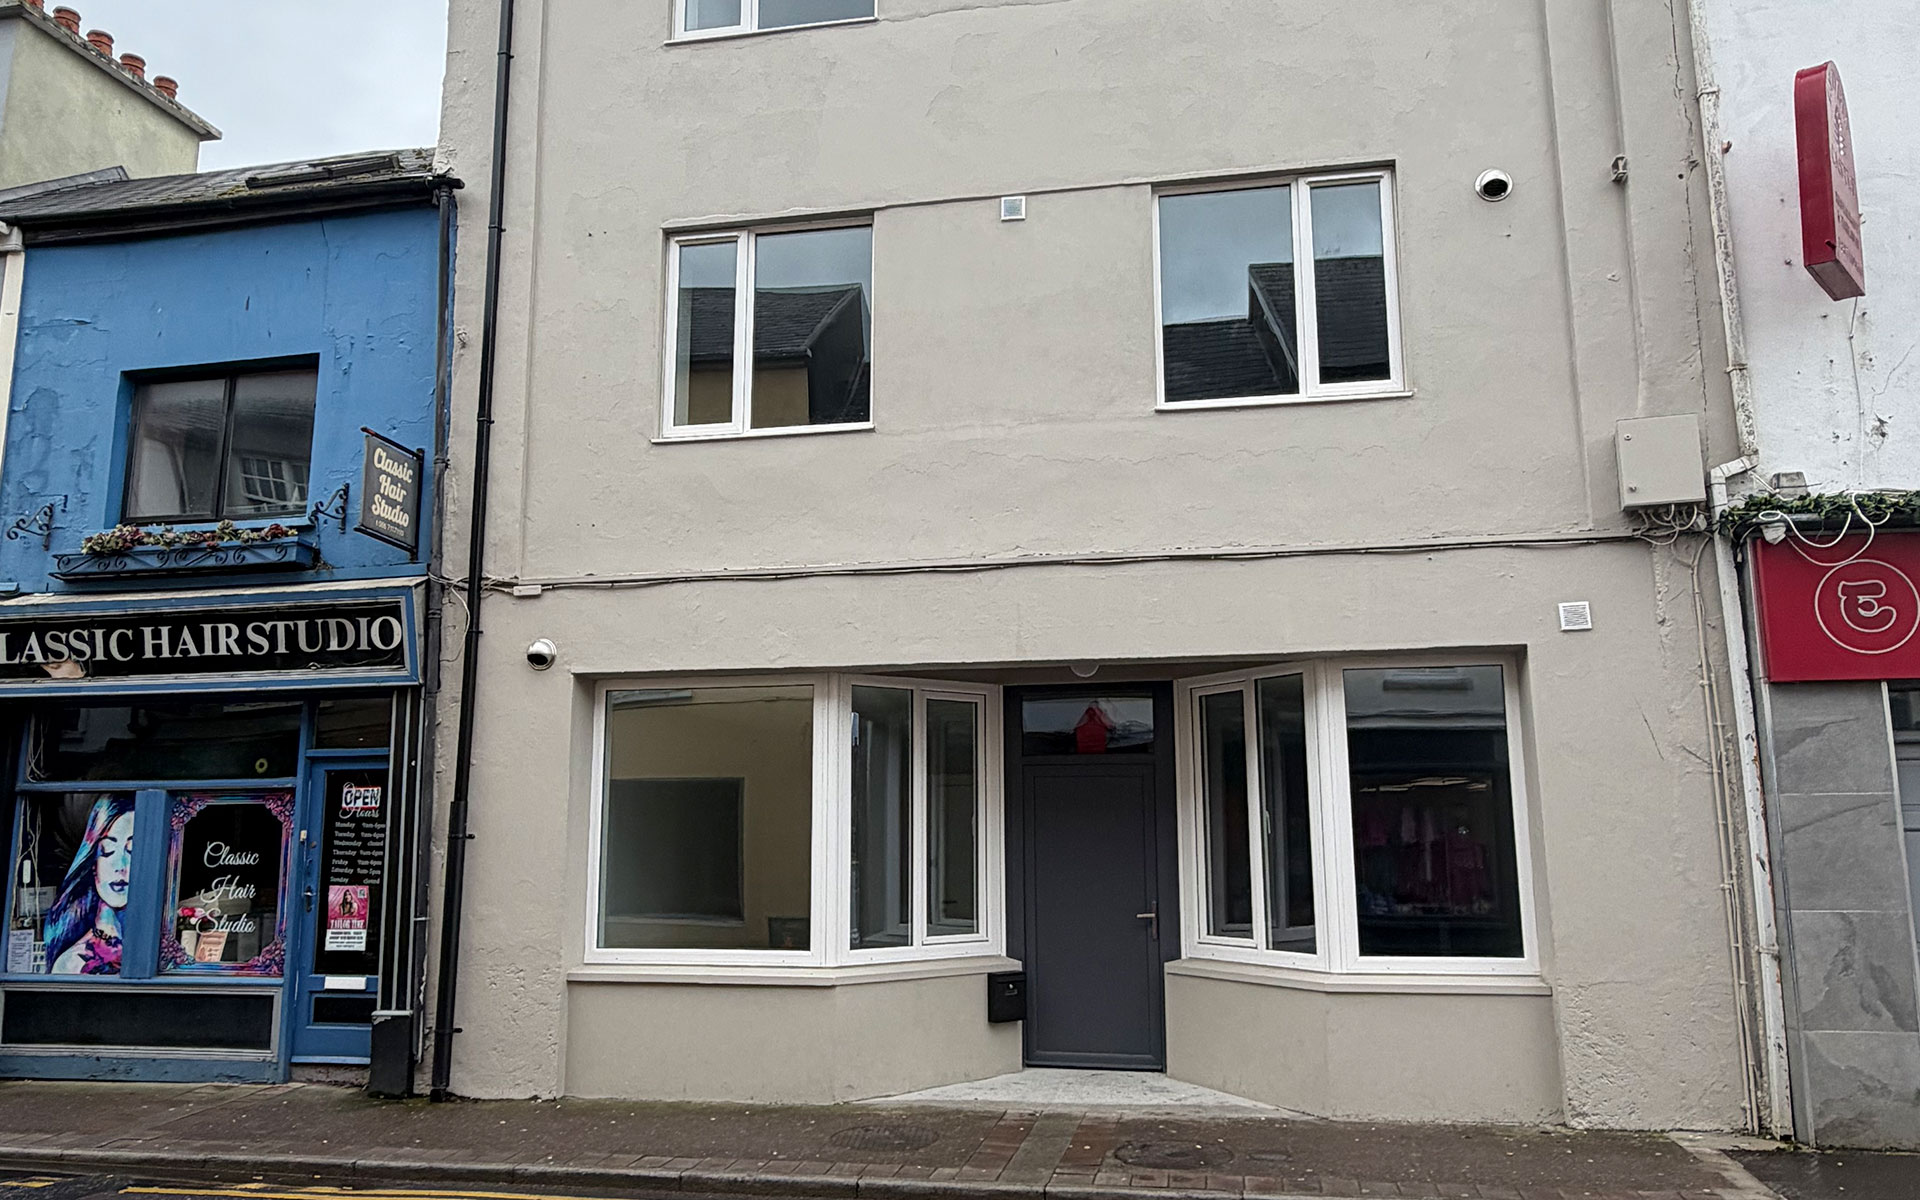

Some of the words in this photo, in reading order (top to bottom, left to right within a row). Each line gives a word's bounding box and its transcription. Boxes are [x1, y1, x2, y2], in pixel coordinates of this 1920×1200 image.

[374, 447, 413, 483] Classic
[379, 474, 407, 503] Hair
[371, 494, 410, 527] Studio
[140, 622, 243, 659] HAIR
[247, 615, 403, 656] STUDIO
[344, 788, 379, 807] OPEN
[204, 841, 260, 868] Classic
[200, 874, 256, 903] Hair
[195, 907, 256, 935] Studio
